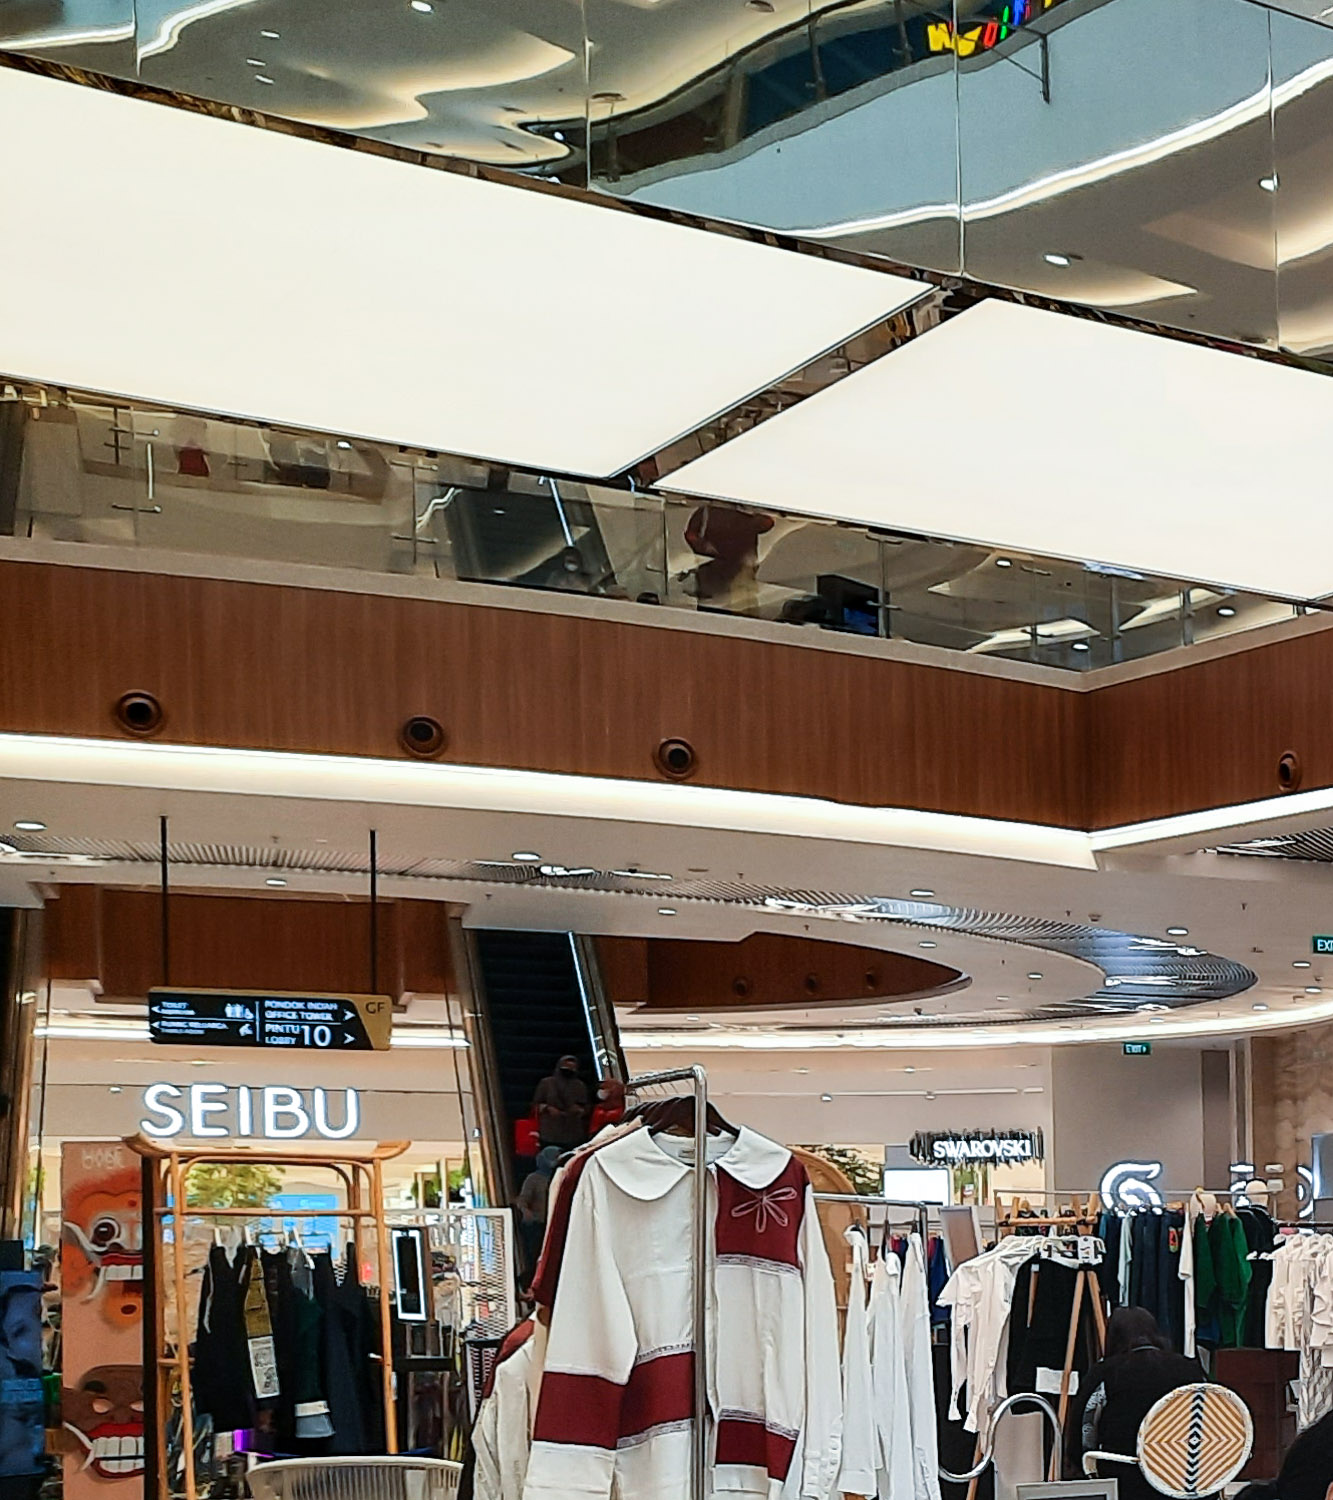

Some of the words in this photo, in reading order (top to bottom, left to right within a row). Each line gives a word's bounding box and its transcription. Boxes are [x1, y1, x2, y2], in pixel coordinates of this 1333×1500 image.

[365, 1002, 385, 1014] GF
[265, 1023, 299, 1034] PINTU
[301, 1025, 331, 1047] 10
[141, 1083, 358, 1138] SEIBU
[933, 1140, 1032, 1158] SWAROVSKI
